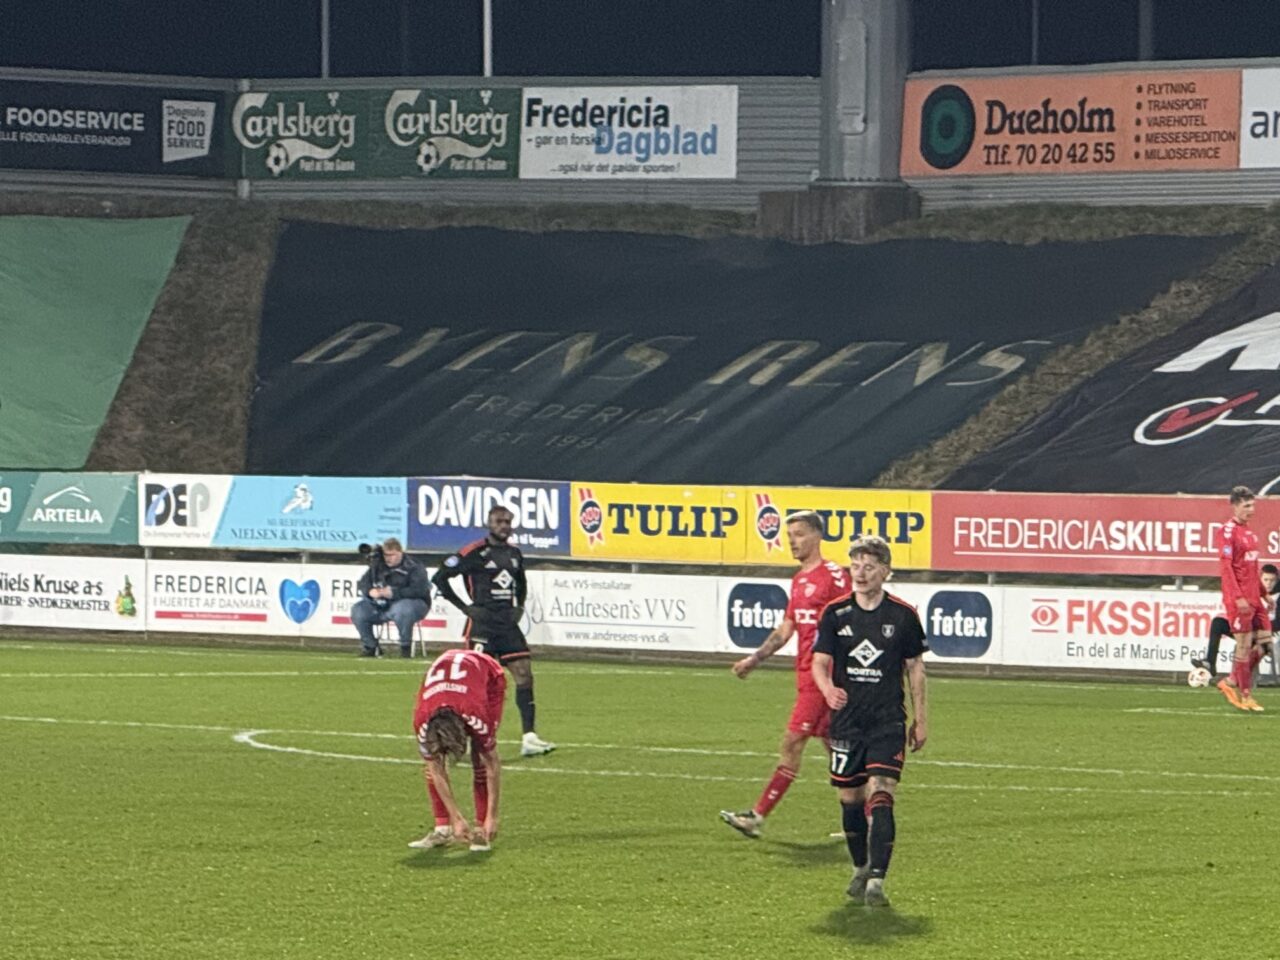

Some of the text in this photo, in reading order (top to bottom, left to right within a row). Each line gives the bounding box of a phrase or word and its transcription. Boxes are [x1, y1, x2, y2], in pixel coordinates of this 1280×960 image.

[1147, 82, 1196, 95] FLYTNING
[525, 97, 670, 127] Fredericia
[985, 97, 1115, 135] Dueholm
[1147, 98, 1209, 111] TRANSPORT
[6, 107, 145, 131] FOODSERVICE
[168, 120, 205, 137] FOOD
[232, 92, 356, 149] Carlsberg
[384, 89, 509, 147] Carlsberg
[1147, 115, 1207, 127] VAREHOTEL
[595, 124, 717, 163] Dagblad
[1145, 130, 1236, 144] MESSESPEDITION
[1016, 144, 1037, 165] 70
[1041, 144, 1063, 164] 20
[1067, 142, 1088, 163] 42
[1092, 142, 1115, 163] 55
[706, 339, 1053, 387] RENS
[450, 393, 709, 424] FREDERICIA
[32, 507, 104, 524] ARTELIA
[418, 485, 560, 531] DAVIDSEN
[607, 502, 739, 538] TULIP
[33, 573, 79, 595] Kruse
[154, 574, 268, 596] FREDERICIA
[159, 597, 201, 608] HJERTET
[203, 598, 217, 608] AF
[218, 599, 269, 610] DANMARK
[549, 596, 686, 622] Andresen's VVS
[1067, 642, 1085, 658] En
[1089, 642, 1110, 659] del
[1113, 644, 1127, 660] af
[1130, 644, 1176, 662] Marius
[831, 752, 848, 774] 17
